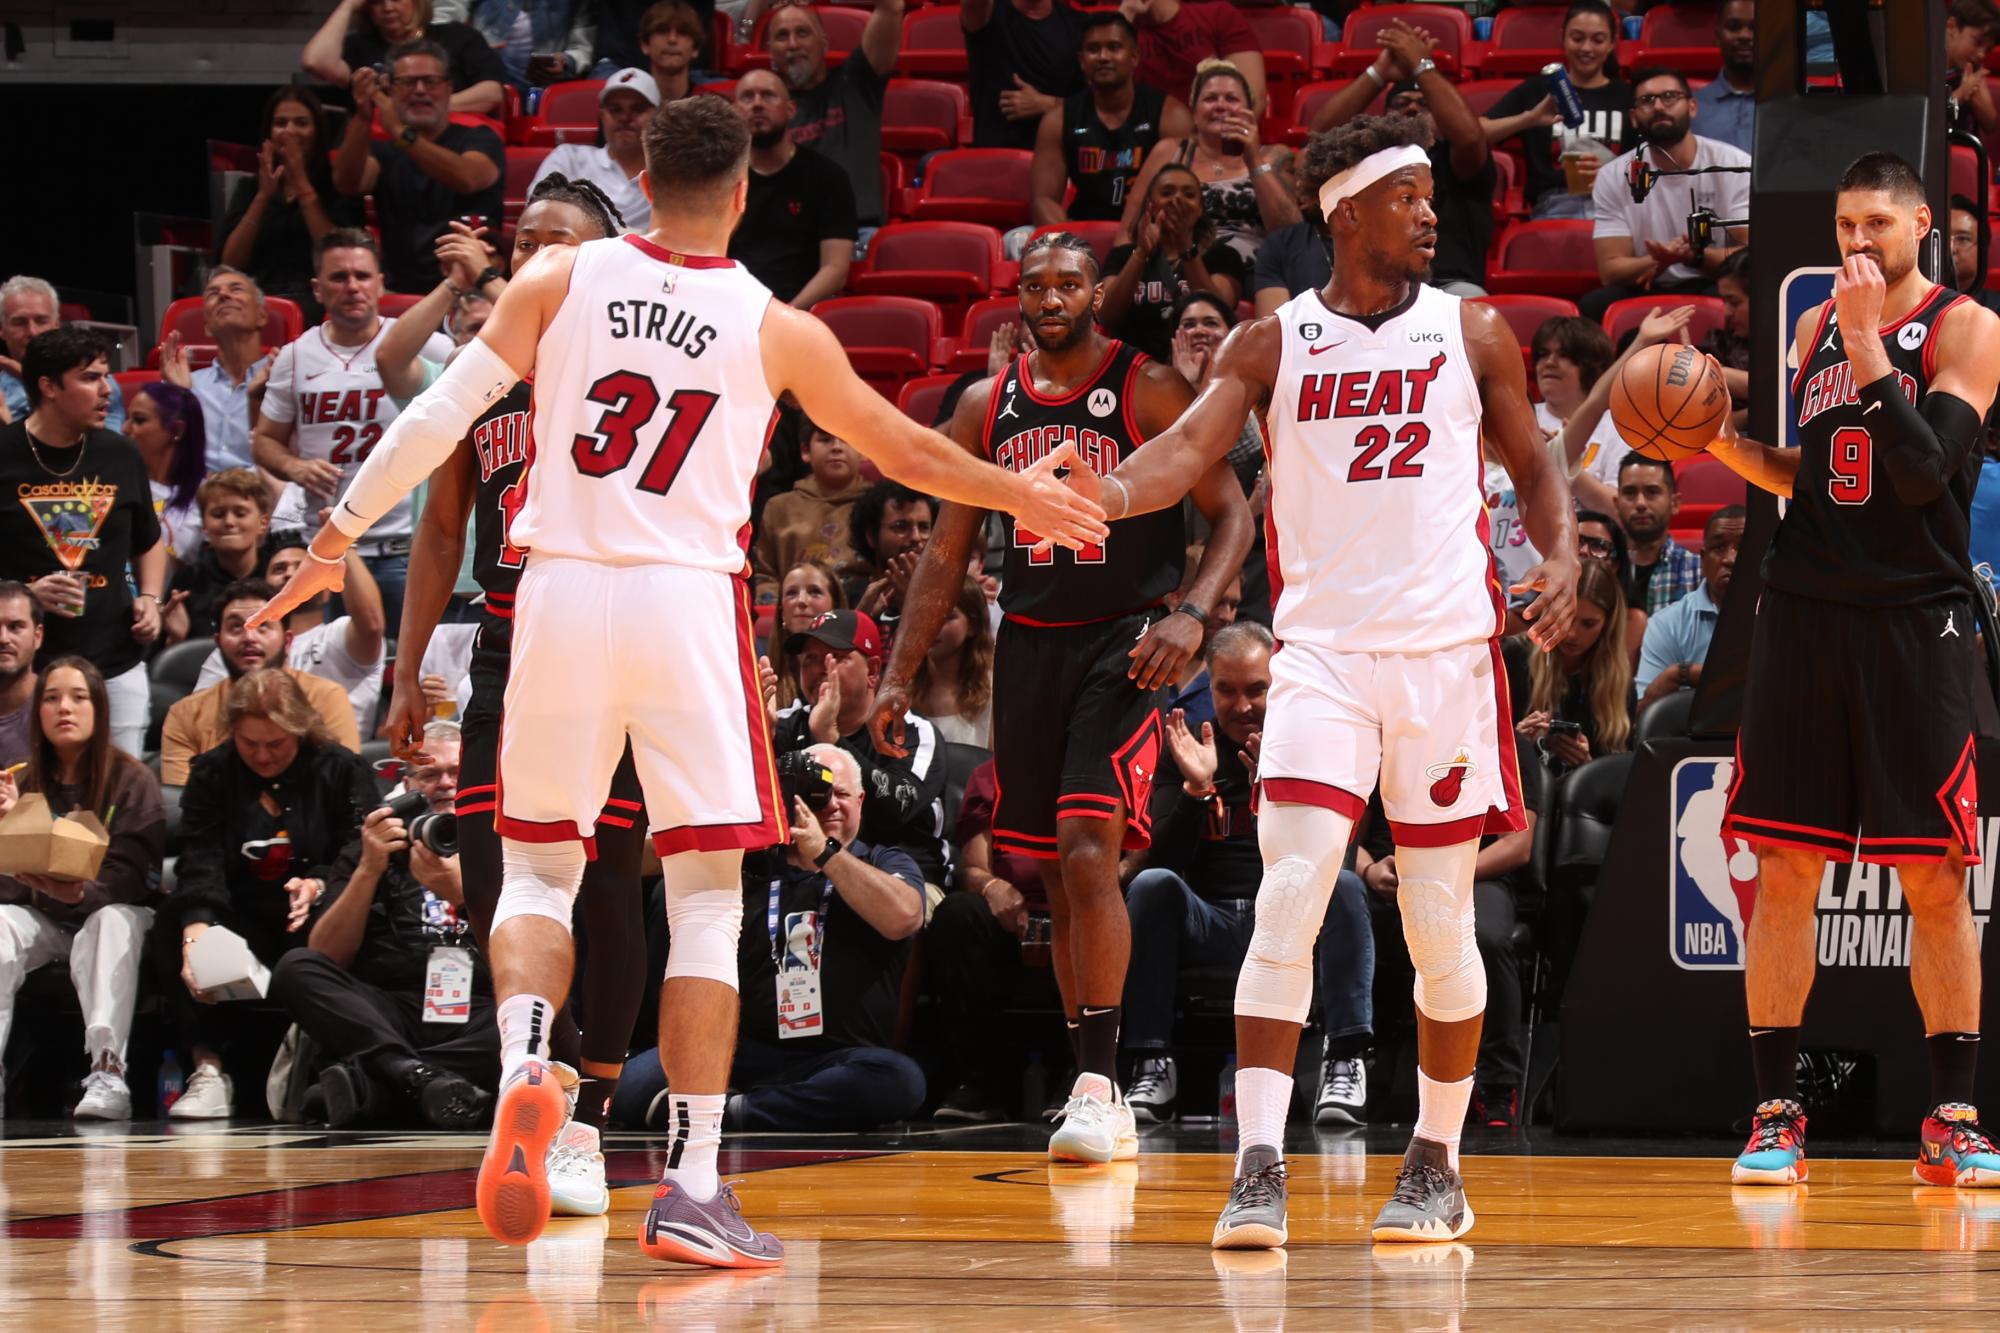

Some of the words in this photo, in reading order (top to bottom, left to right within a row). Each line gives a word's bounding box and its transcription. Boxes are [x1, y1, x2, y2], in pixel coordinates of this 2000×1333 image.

[1112, 176, 1136, 206] 1
[1134, 280, 1191, 304] ULS
[607, 300, 718, 359] STRUS
[1409, 333, 1444, 343] UKG
[1006, 379, 1017, 393] 6
[1297, 351, 1447, 422] HEAT
[1798, 360, 1918, 428] CHIO
[299, 388, 386, 425] HEAT
[330, 423, 384, 464] 22
[474, 411, 531, 483] CHI
[570, 369, 721, 497] 31
[1347, 421, 1431, 483] 22
[1828, 426, 1872, 506] 9
[1495, 518, 1527, 549] 13
[1684, 922, 1728, 955] NBA
[1930, 1142, 1941, 1159] 13
